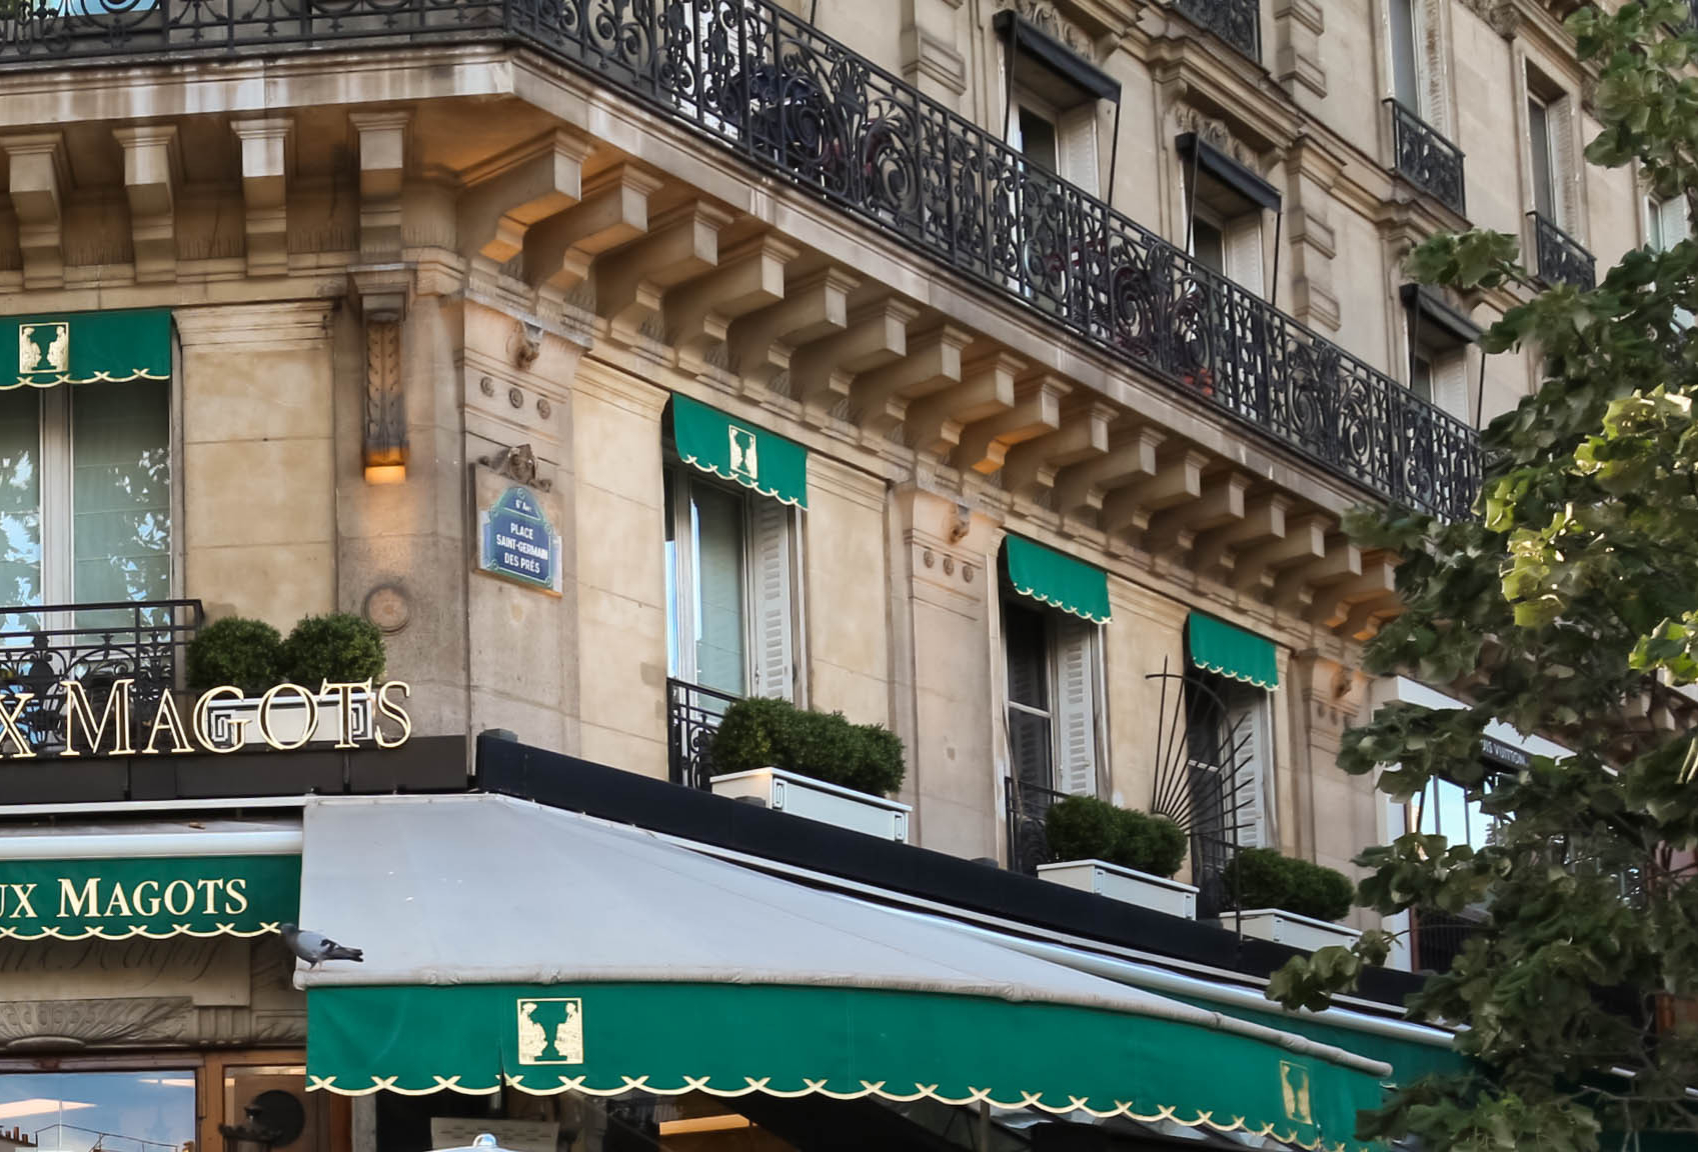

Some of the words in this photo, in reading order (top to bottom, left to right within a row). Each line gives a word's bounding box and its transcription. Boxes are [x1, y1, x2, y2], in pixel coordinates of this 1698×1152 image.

[510, 522, 534, 540] PLACE
[496, 533, 549, 560] SAINT-GERMAIN
[504, 552, 519, 567] DES
[520, 557, 541, 574] PRÉS
[59, 676, 412, 757] MAGOTS
[56, 877, 249, 918] MAGOTS
